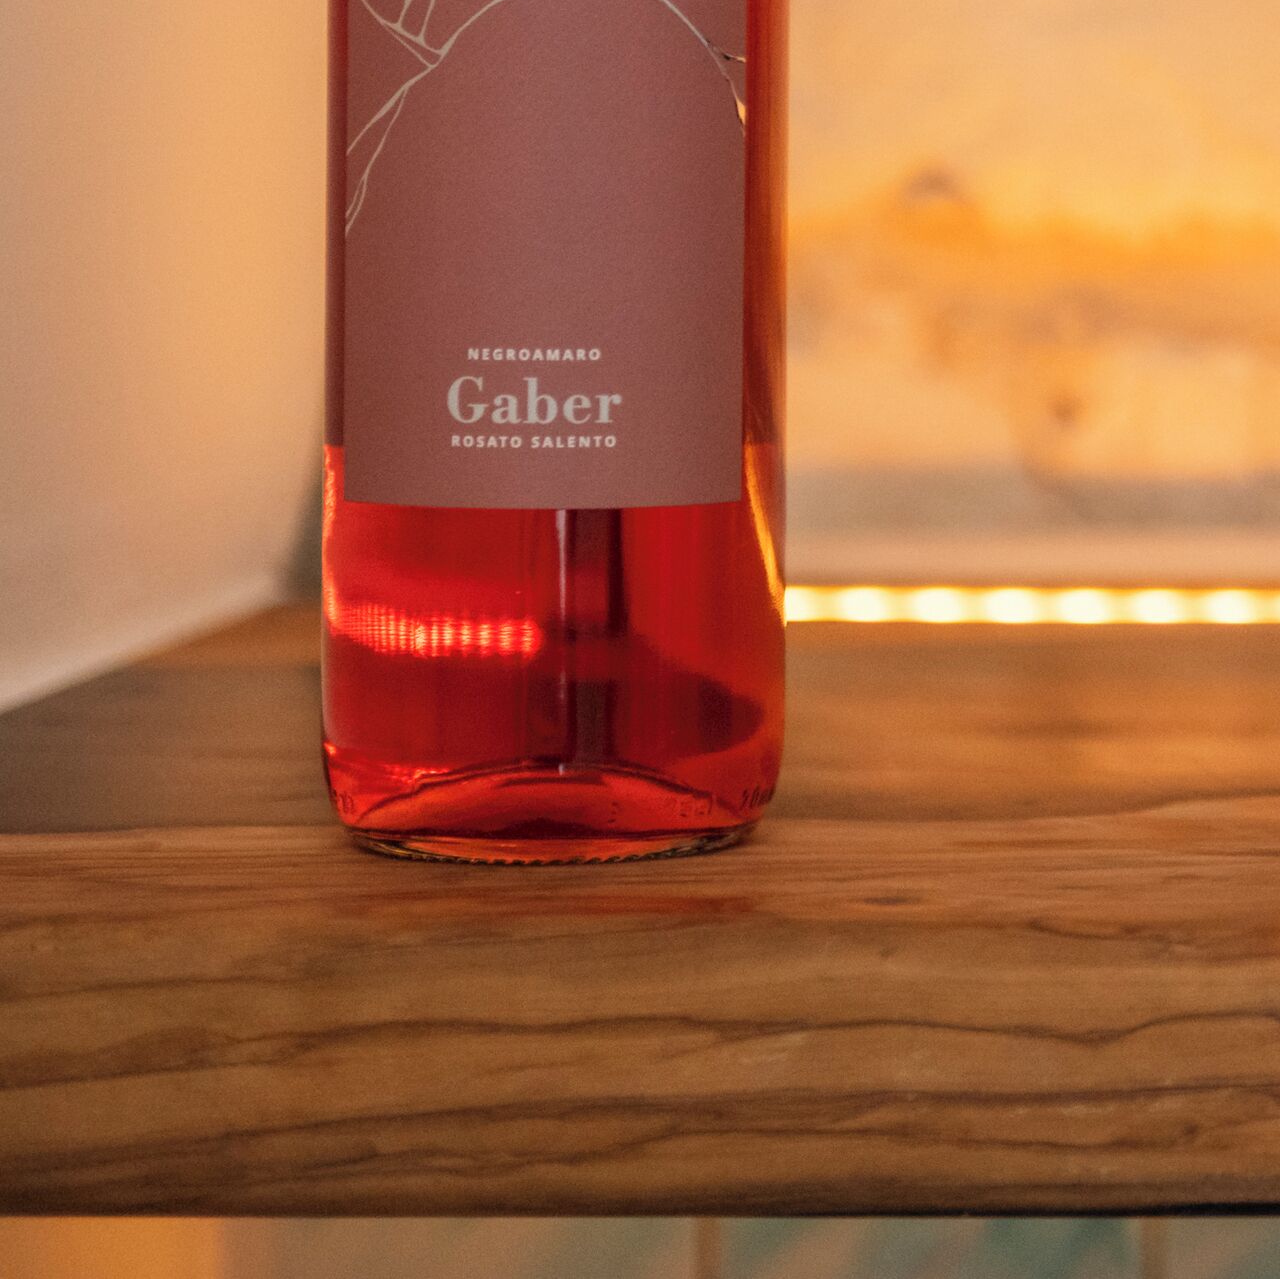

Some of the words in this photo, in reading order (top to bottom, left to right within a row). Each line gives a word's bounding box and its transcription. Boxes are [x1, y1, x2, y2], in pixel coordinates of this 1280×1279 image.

[468, 348, 601, 361] NEGROAMARO
[447, 376, 622, 424] Gaber
[451, 435, 522, 448] ROSATO
[531, 435, 617, 448] SALENTO
